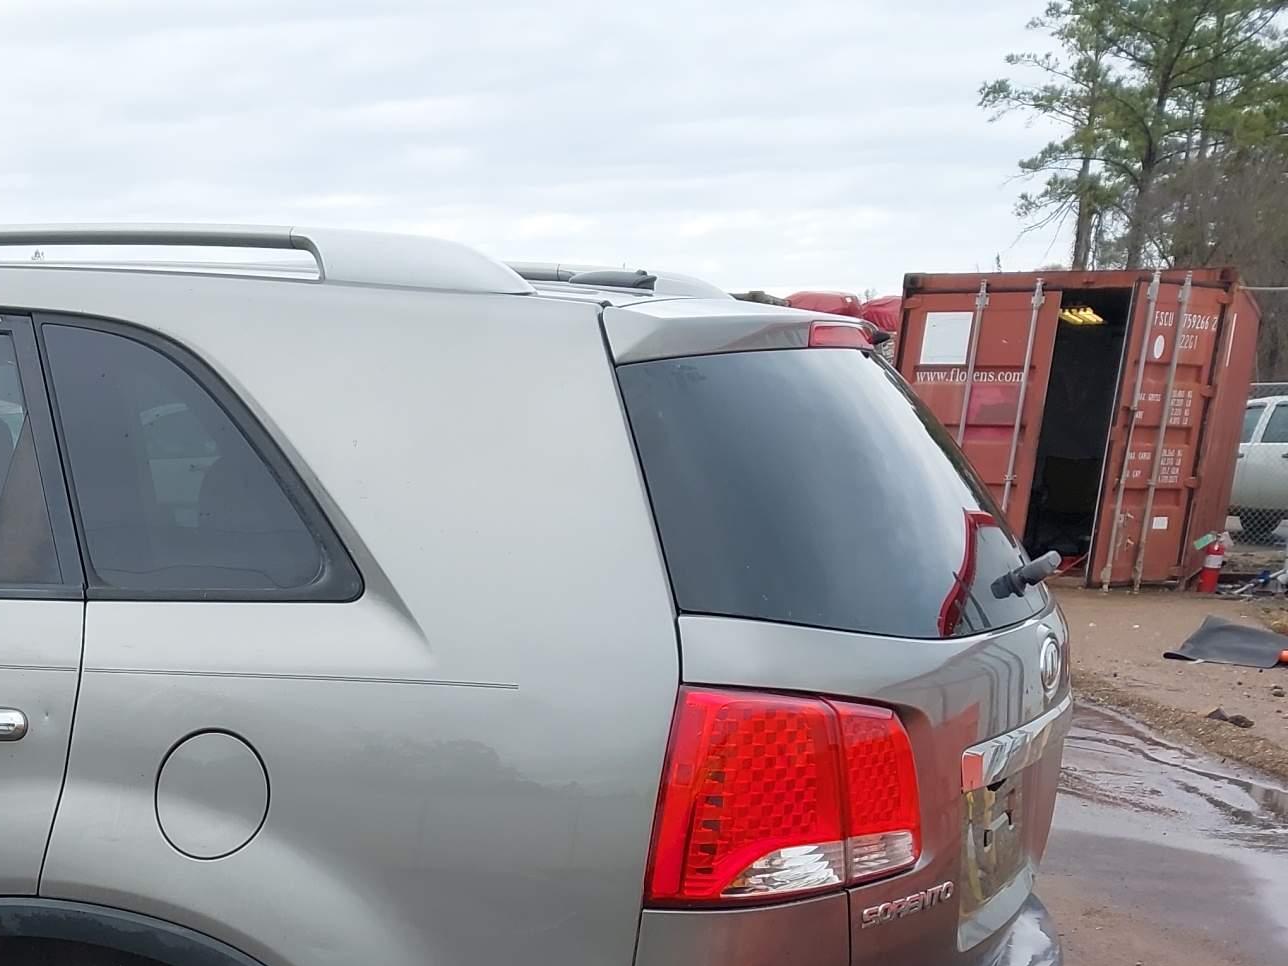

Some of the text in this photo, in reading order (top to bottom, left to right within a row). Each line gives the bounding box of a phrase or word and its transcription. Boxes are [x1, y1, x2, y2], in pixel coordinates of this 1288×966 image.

[1154, 310, 1175, 327] FSCU
[916, 367, 1024, 383] www.floens.com
[861, 881, 954, 928] SORENTO
